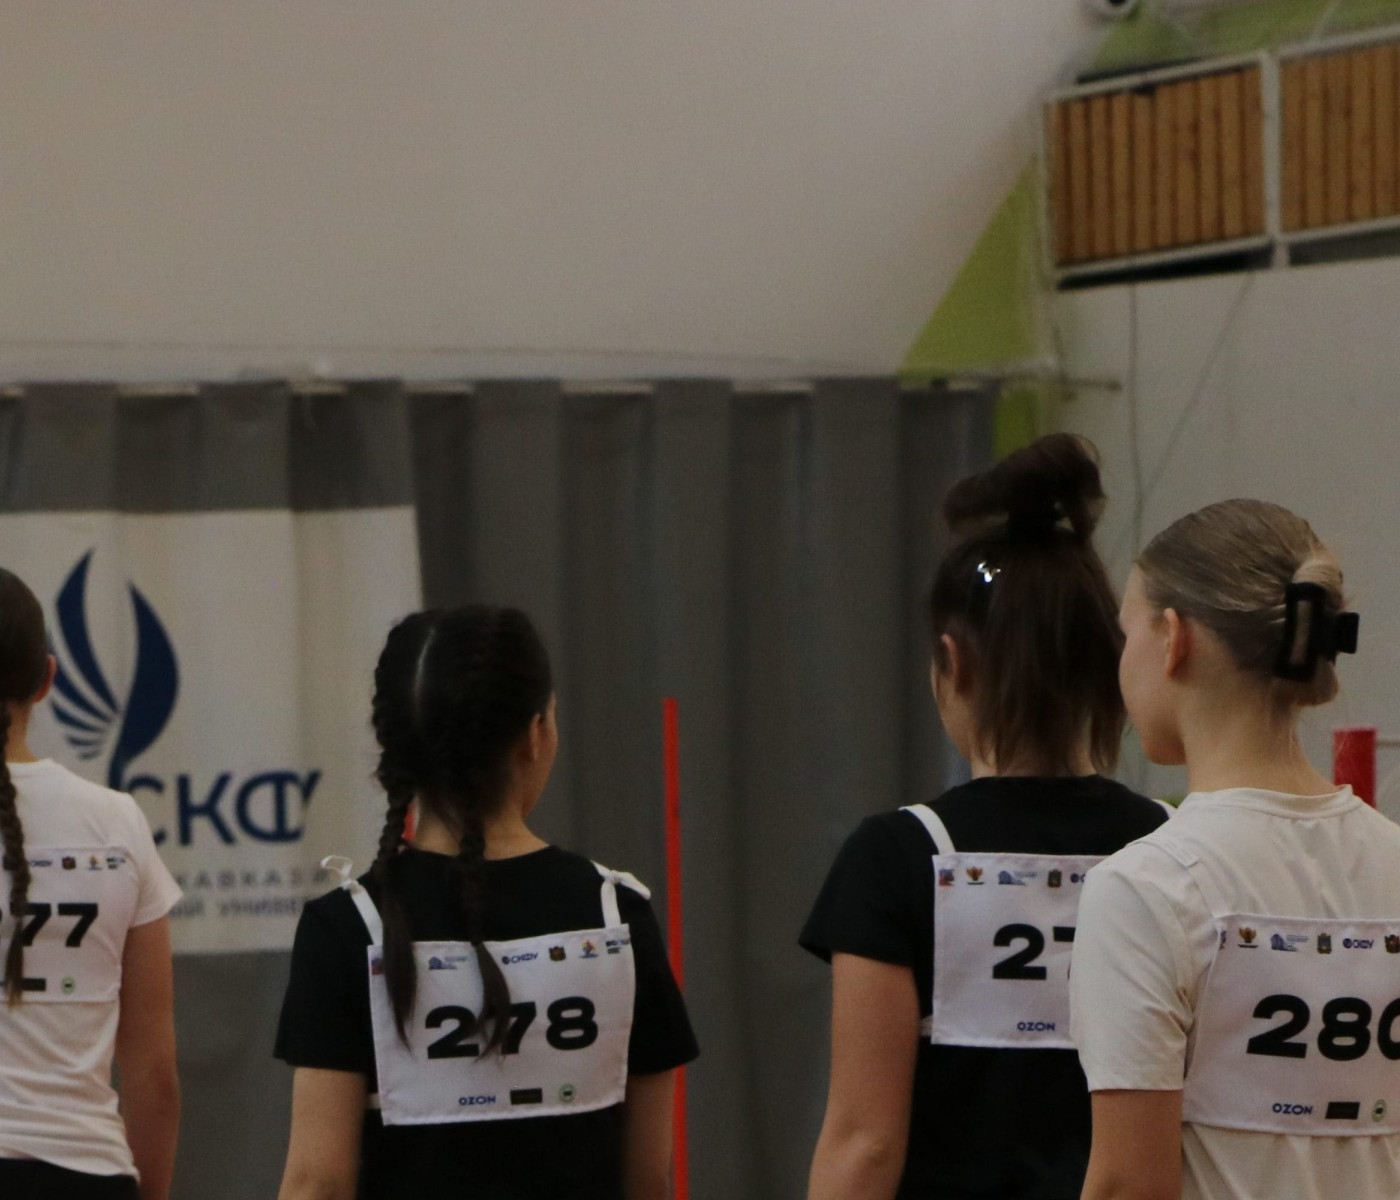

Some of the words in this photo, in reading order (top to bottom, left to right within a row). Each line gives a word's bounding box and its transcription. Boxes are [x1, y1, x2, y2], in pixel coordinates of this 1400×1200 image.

[425, 996, 599, 1060] 278
[1017, 1021, 1056, 1032] OZON
[458, 1095, 496, 1106] OZON
[1272, 1102, 1313, 1115] OZON
